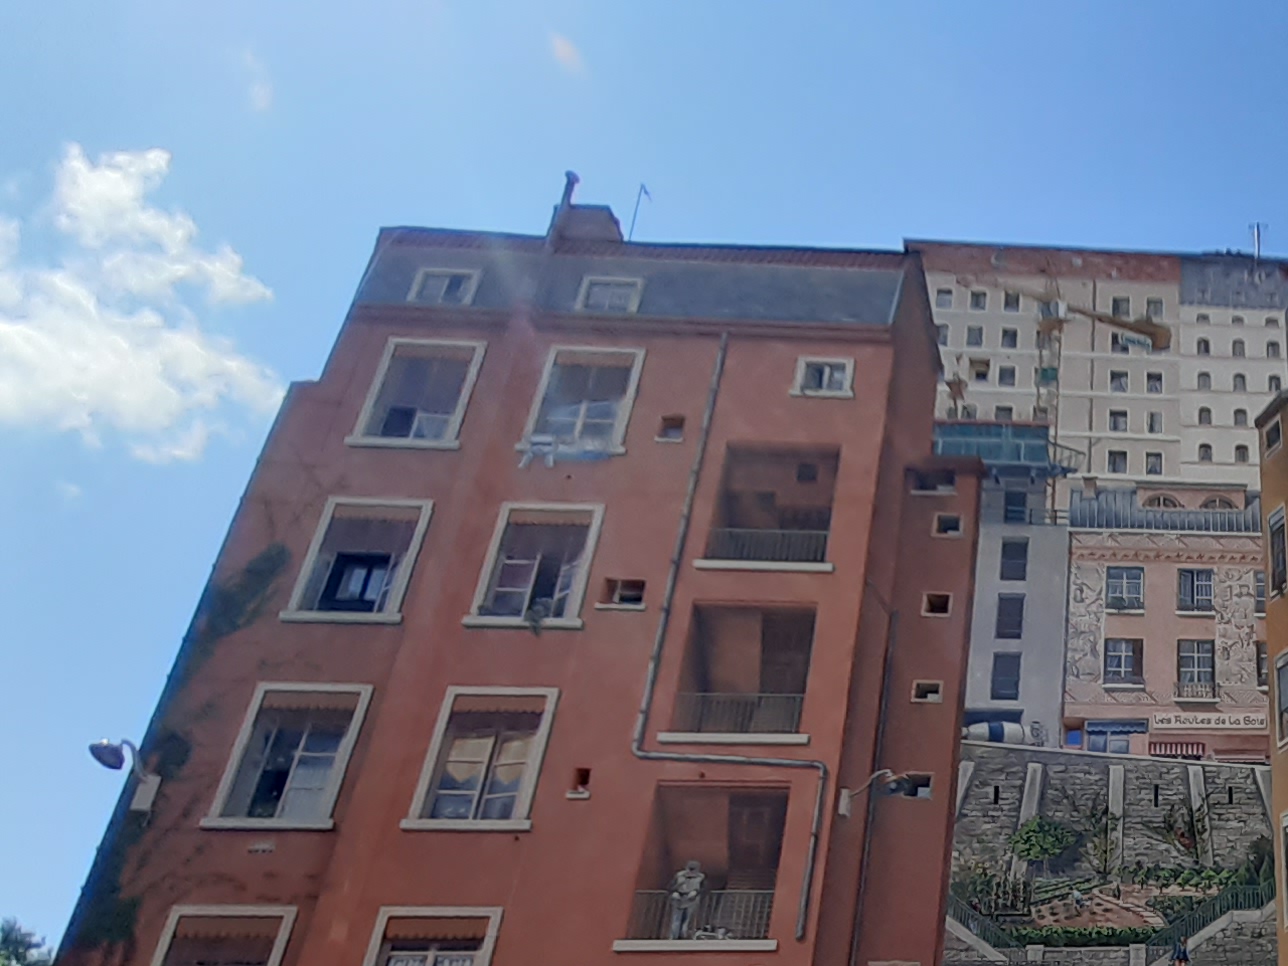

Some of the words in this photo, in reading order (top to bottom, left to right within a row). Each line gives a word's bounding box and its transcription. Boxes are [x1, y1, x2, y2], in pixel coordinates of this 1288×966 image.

[1154, 714, 1172, 725] Les
[1174, 715, 1212, 725] Routes
[1214, 715, 1226, 725] de
[1243, 715, 1265, 726] Soie
